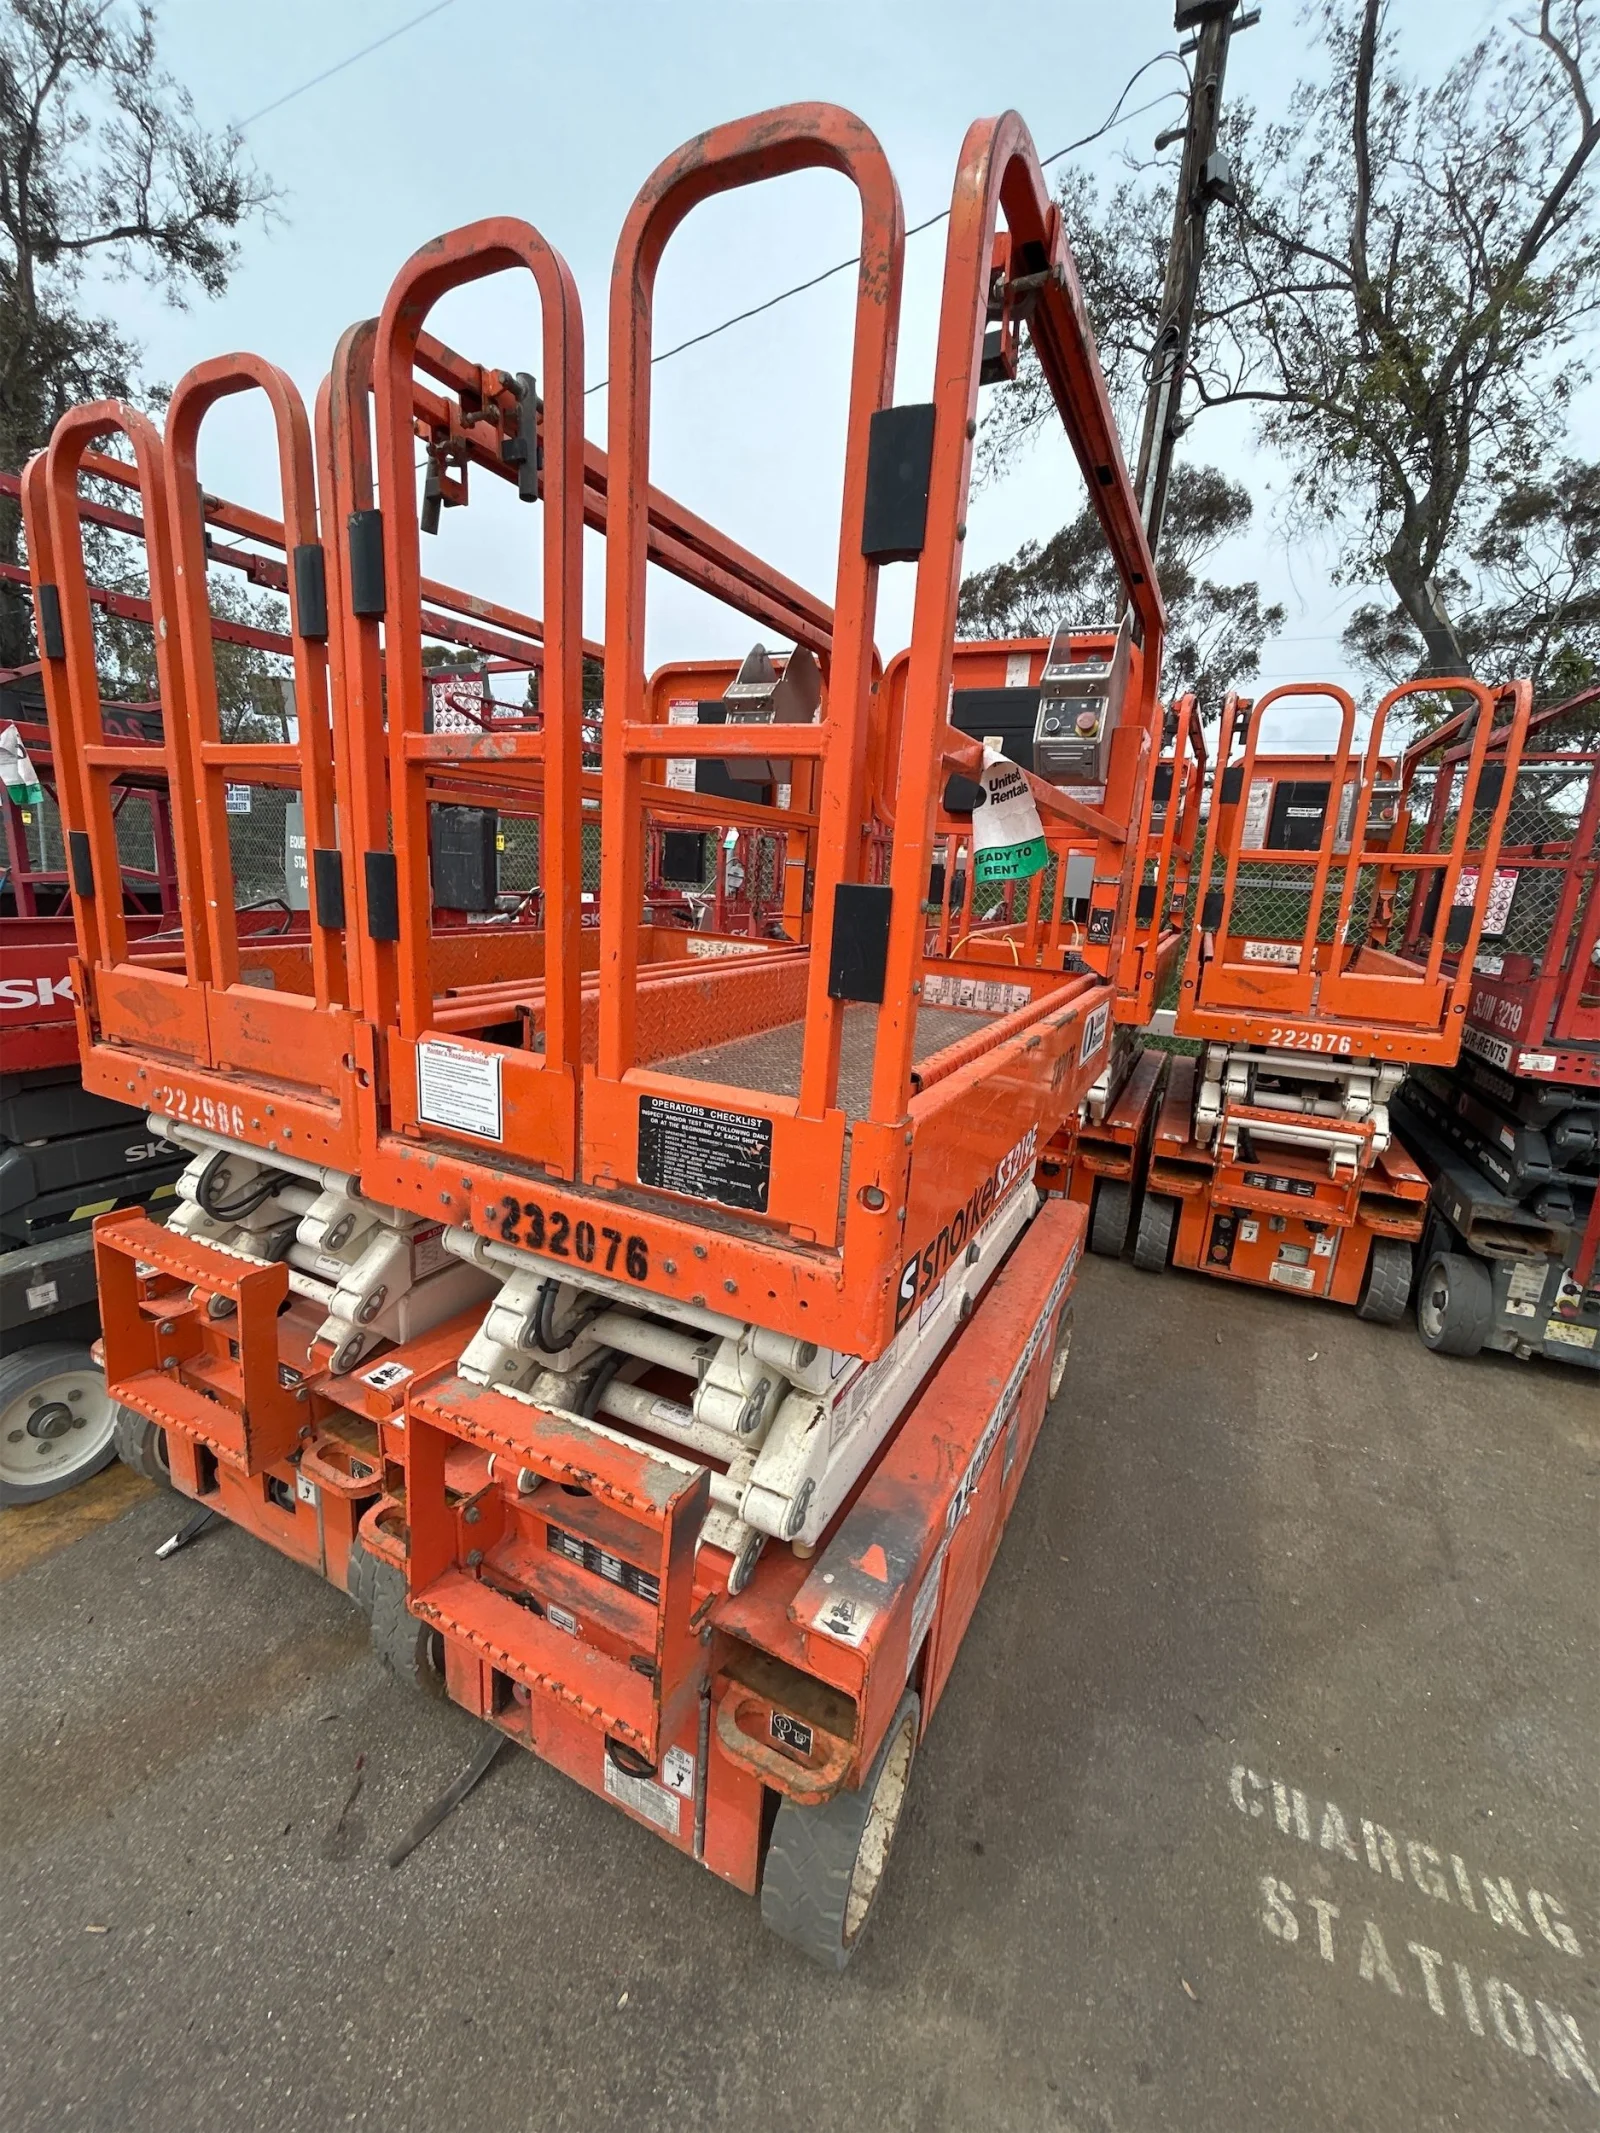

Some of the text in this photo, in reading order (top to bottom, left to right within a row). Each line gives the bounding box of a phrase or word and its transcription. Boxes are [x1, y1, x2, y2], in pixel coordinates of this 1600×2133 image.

[989, 767, 1022, 792] United
[990, 782, 1029, 806] Rentals
[1015, 847, 1031, 858] TO
[984, 864, 1019, 876] RENT
[1495, 1000, 1522, 1032] 3219
[1269, 1028, 1351, 1053] 222976
[641, 1109, 663, 1118] INSPECT
[716, 1125, 750, 1136] FOLLOWING
[752, 1132, 768, 1140] DAILY
[651, 1099, 763, 1128] OPERATORS CHECKLIST
[681, 1124, 711, 1135] BEGINNING
[723, 1133, 739, 1141] EACH
[501, 1196, 649, 1281] 232076
[920, 1161, 1000, 1297] snorkel
[1227, 1764, 1584, 1958] CHARGING
[1261, 1876, 1600, 2094] STATION
